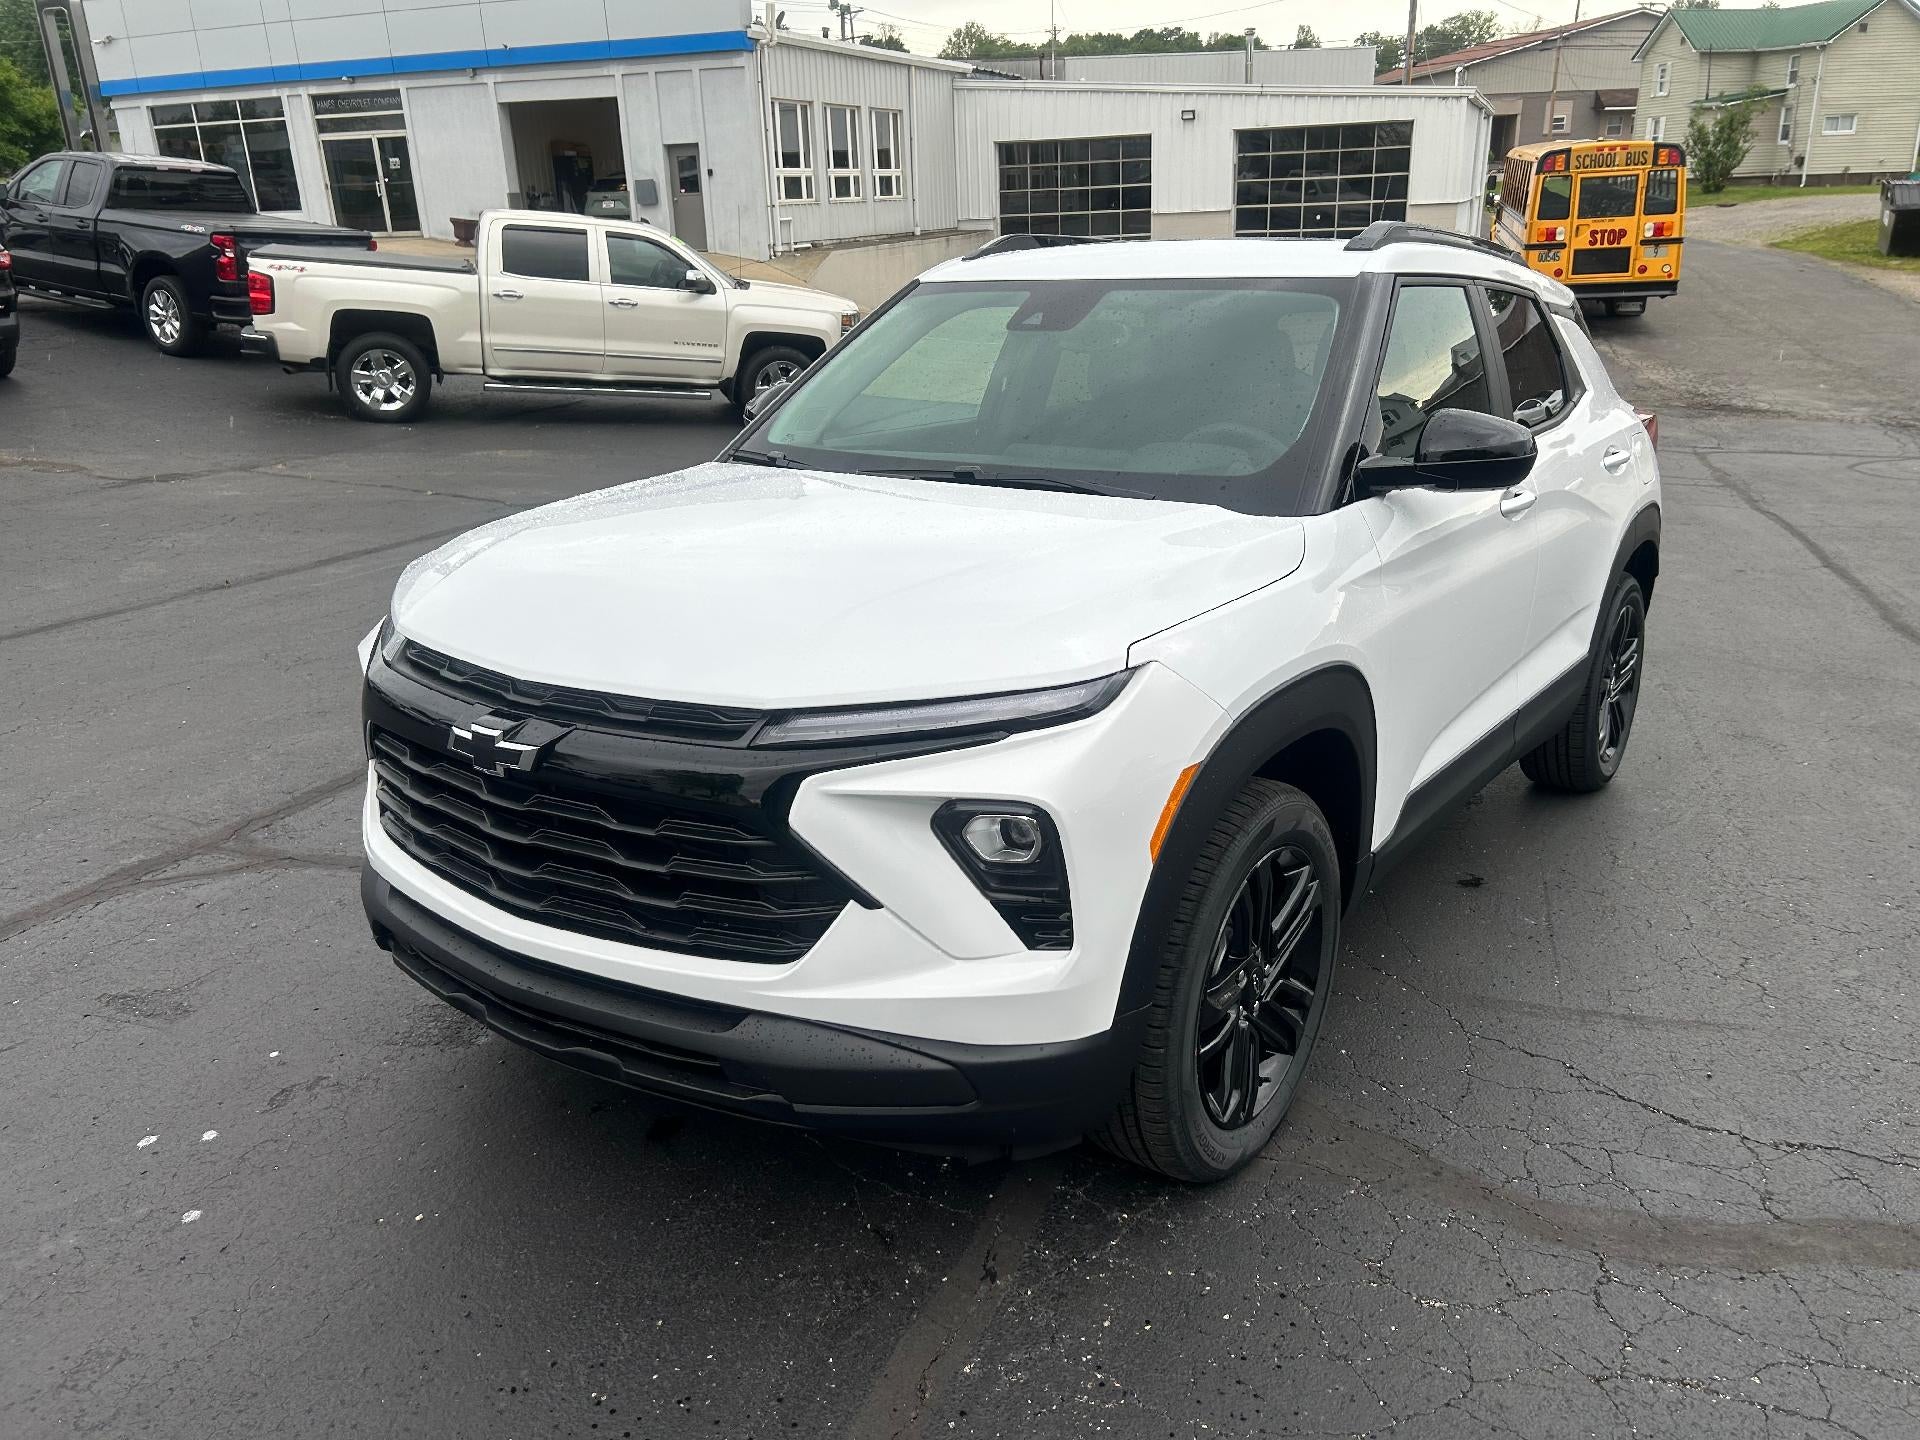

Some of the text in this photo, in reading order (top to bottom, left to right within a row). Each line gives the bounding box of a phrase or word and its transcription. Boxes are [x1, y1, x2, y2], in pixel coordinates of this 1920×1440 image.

[337, 98, 371, 107] CHEVROLET
[373, 96, 401, 104] COMPANY
[1575, 150, 1649, 169] SCHOOL BUS
[1588, 228, 1627, 247] STOP
[1653, 247, 1659, 258] 9
